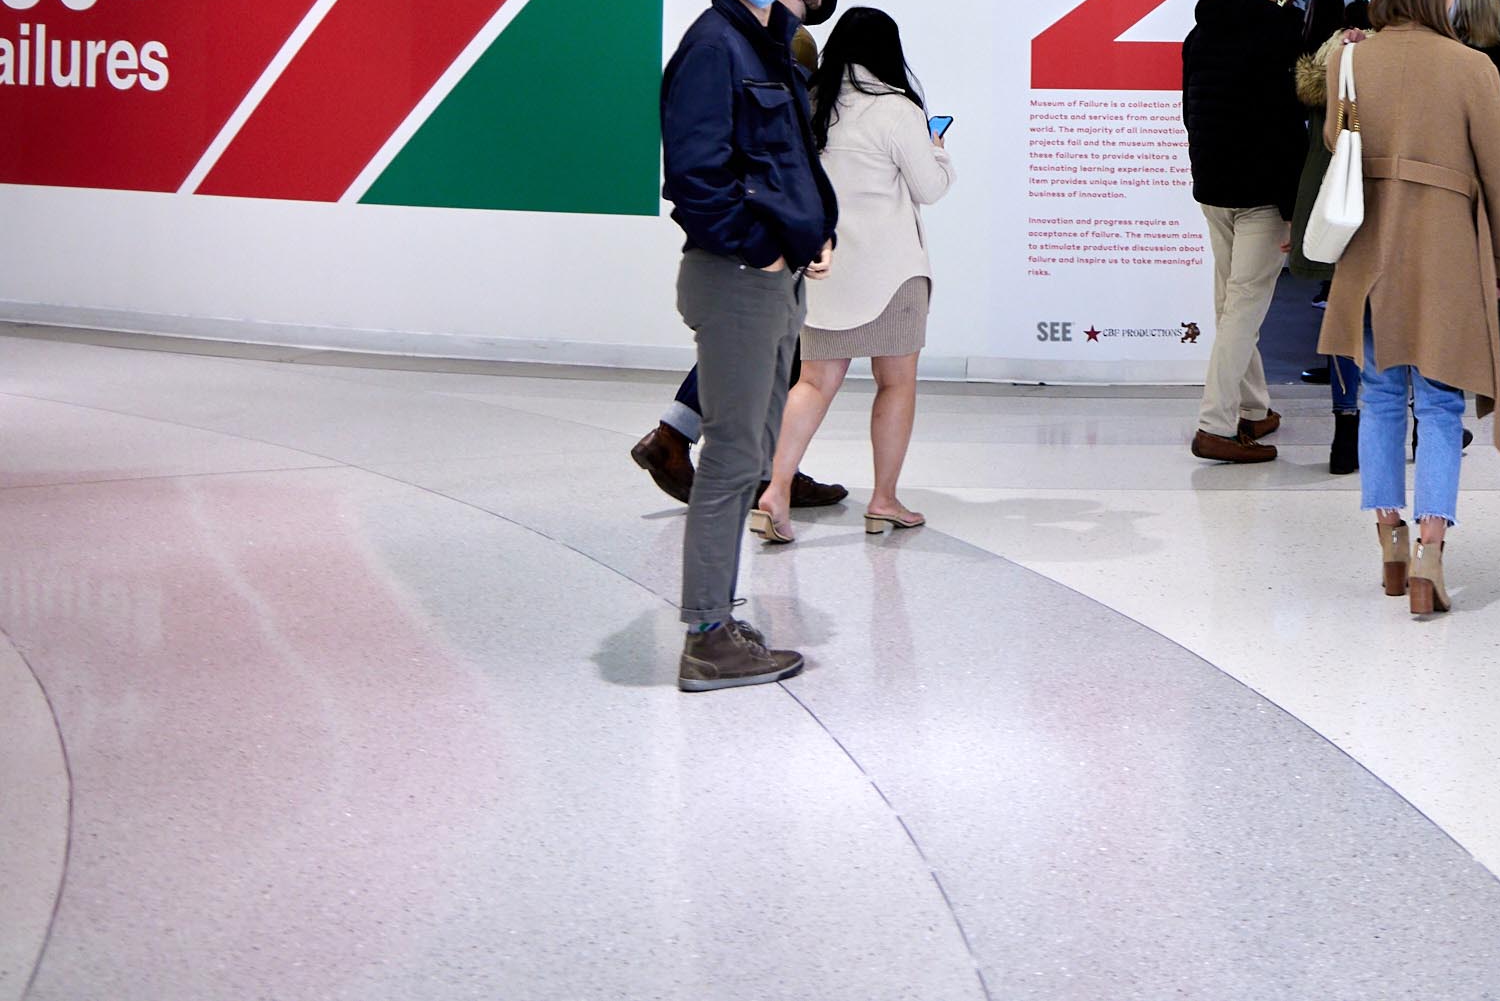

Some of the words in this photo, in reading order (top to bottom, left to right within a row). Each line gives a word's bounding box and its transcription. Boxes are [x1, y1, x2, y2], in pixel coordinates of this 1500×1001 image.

[0, 23, 169, 91] ailures
[1102, 153, 1134, 161] provide
[1029, 165, 1077, 173] fascinating
[1118, 166, 1168, 174] experience.
[1094, 219, 1132, 227] progress
[1028, 231, 1077, 239] acceptance
[1083, 244, 1129, 252] productive
[1077, 257, 1106, 265] inspire
[1154, 258, 1203, 266] meaningful
[1037, 322, 1072, 341] SEE
[1122, 329, 1182, 337] PRODUCTIONS
